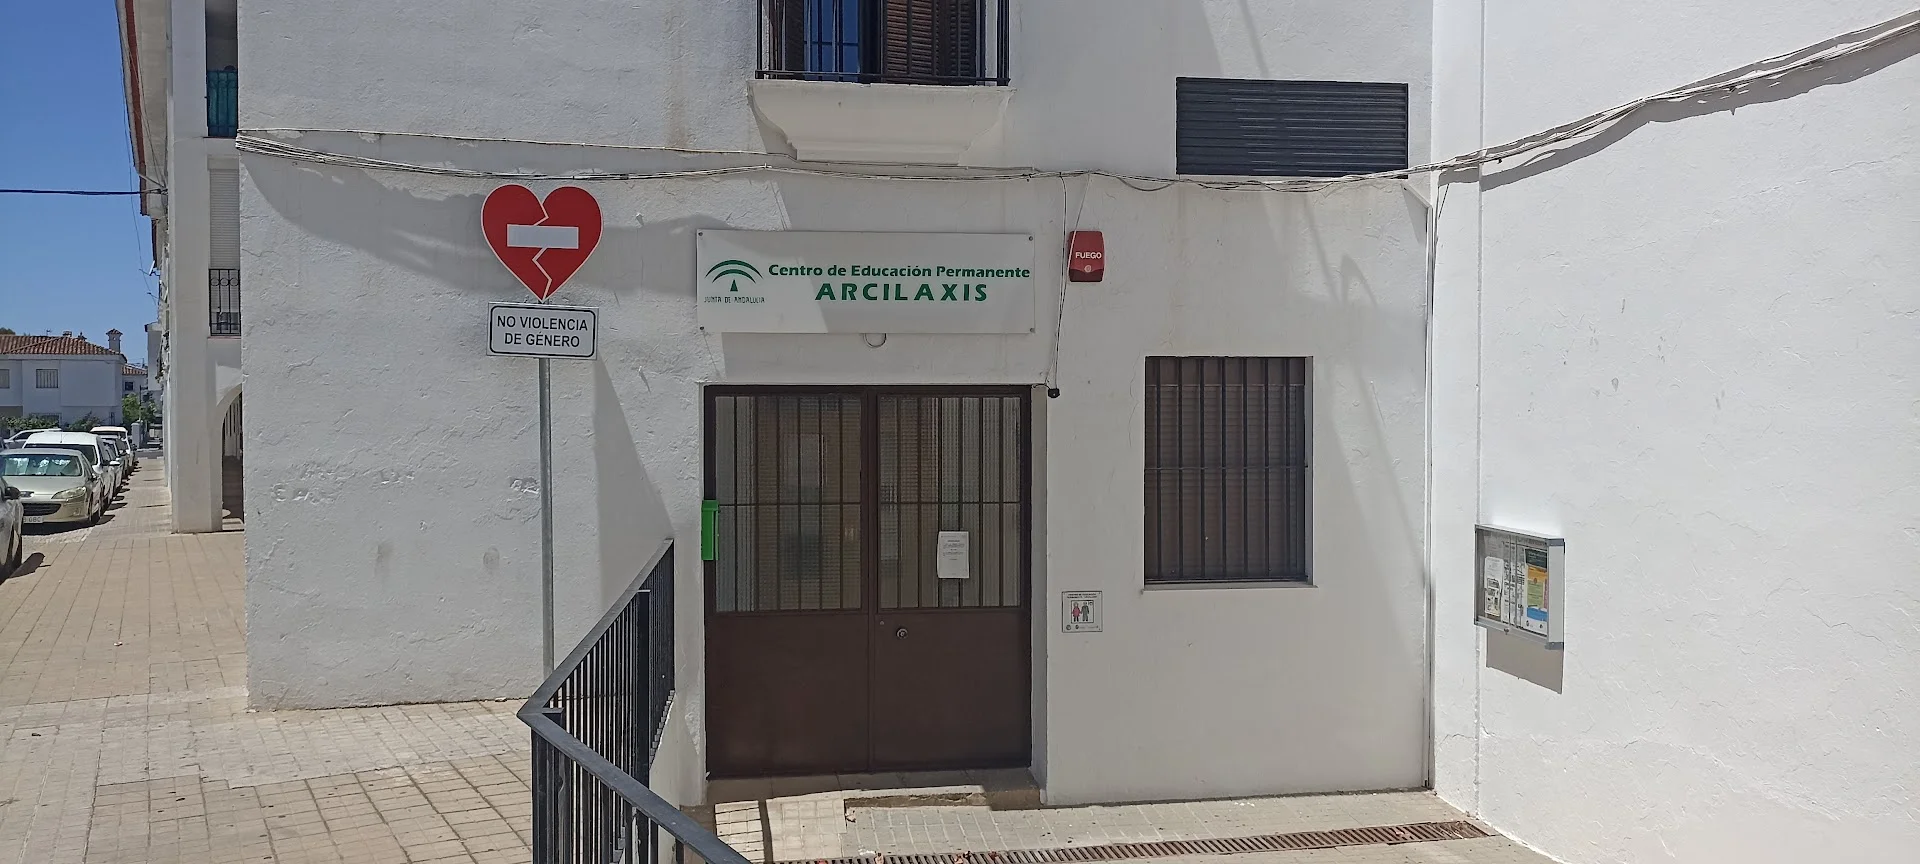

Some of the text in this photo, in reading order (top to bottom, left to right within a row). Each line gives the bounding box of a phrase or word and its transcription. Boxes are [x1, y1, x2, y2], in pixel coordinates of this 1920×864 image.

[1071, 251, 1102, 260] FUEGO
[768, 264, 1031, 278] Centro de Educación Permanente
[814, 282, 988, 302] ARCILAXIS
[724, 296, 732, 304] DE
[497, 315, 588, 331] NO VIOLENCIA
[504, 331, 580, 348] DE GÉNERO
